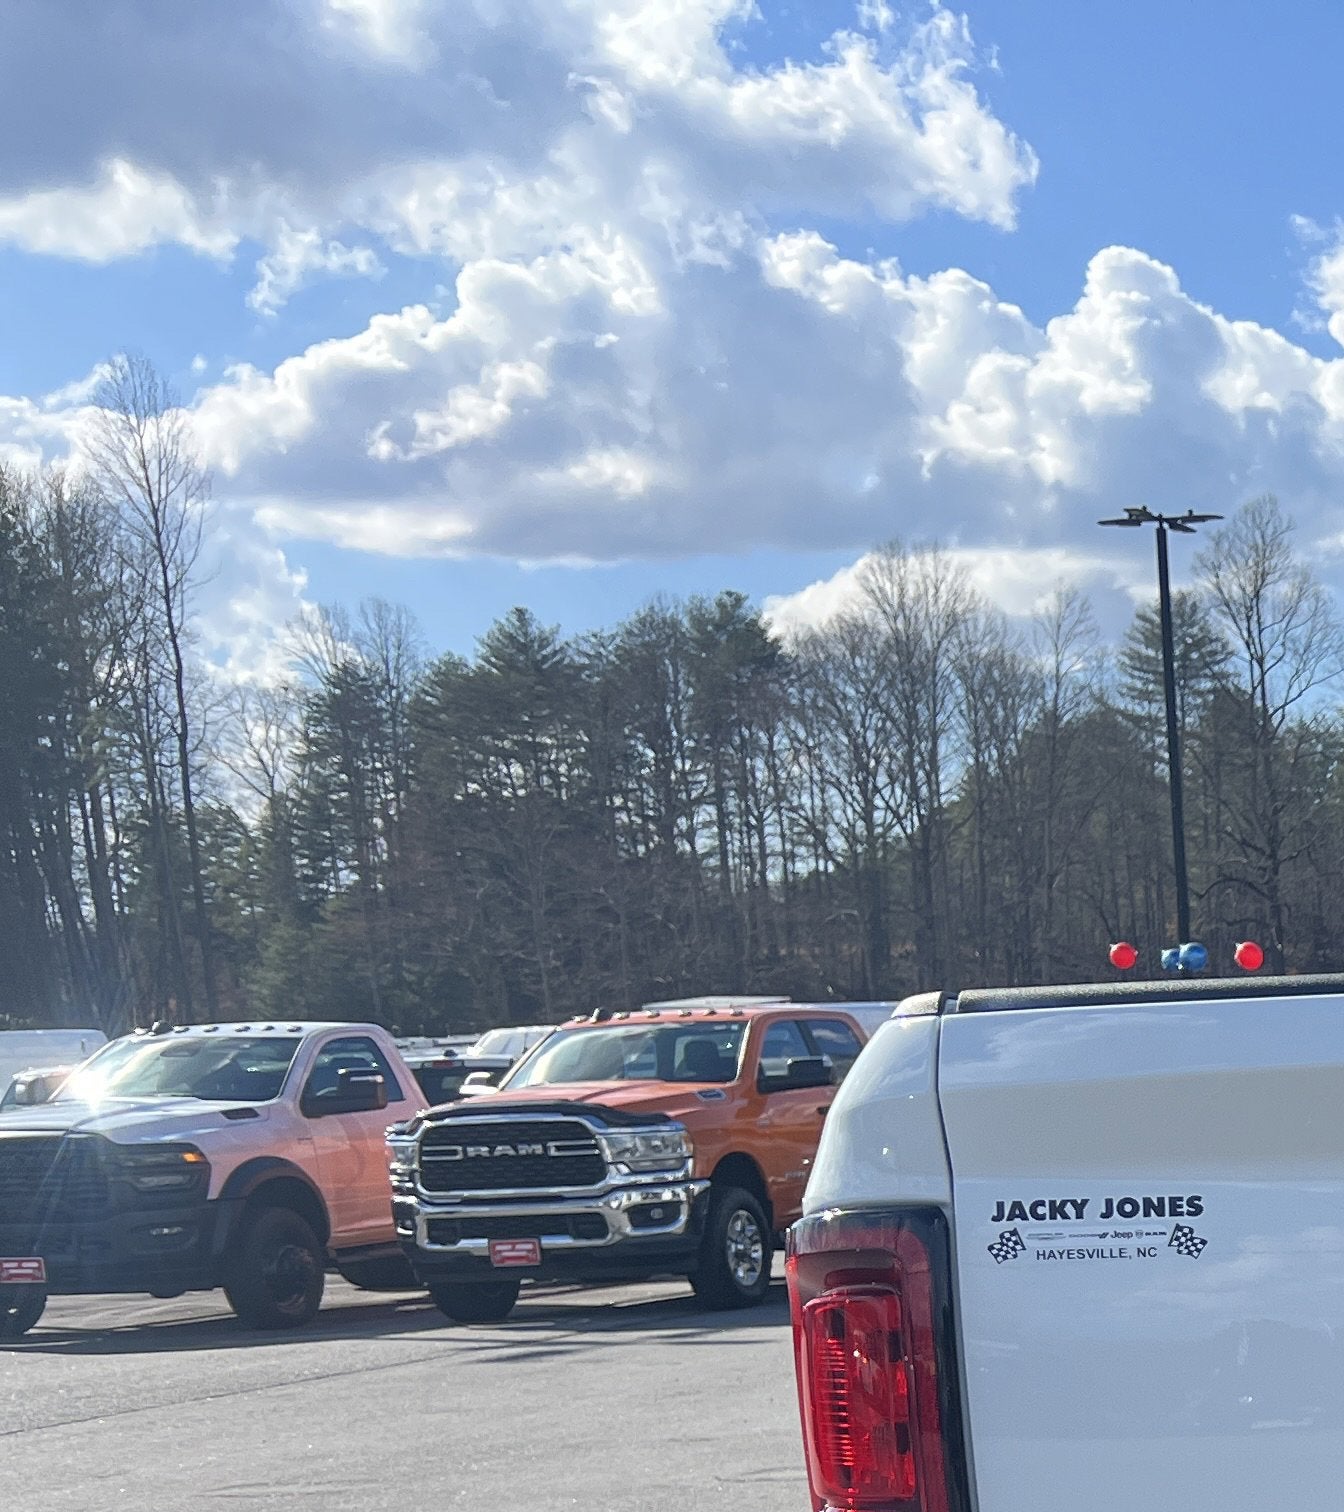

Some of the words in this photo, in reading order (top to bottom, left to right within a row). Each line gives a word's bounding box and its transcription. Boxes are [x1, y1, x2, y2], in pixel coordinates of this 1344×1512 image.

[466, 1144, 543, 1158] RAM
[990, 1198, 1090, 1222] JACKY
[1099, 1195, 1205, 1219] JONES
[1110, 1230, 1134, 1240] Jeep
[1036, 1248, 1133, 1261] HAYESVILLE,
[1136, 1247, 1158, 1259] NC
